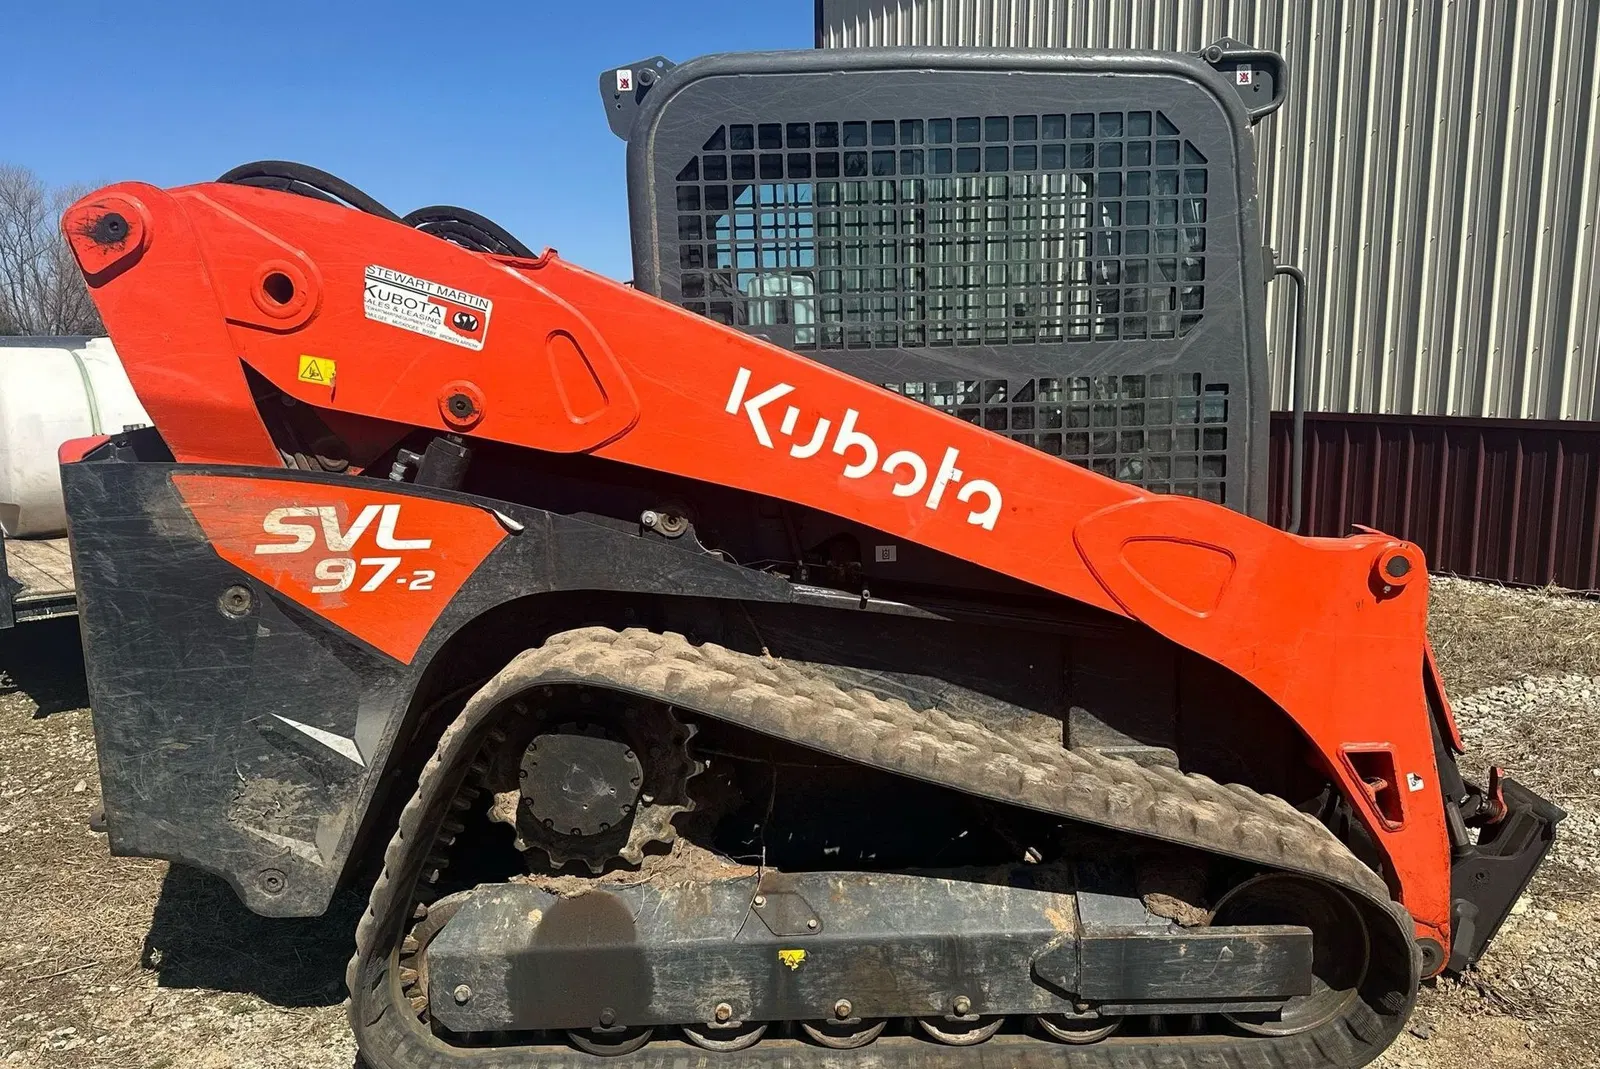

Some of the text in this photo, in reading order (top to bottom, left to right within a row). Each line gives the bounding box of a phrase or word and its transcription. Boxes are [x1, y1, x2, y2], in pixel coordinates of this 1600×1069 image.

[364, 281, 441, 318] KUBOTA
[366, 264, 489, 309] STEWART MARTIN
[392, 301, 399, 312] &
[401, 308, 441, 325] LEASING
[725, 367, 1003, 531] Kubota
[254, 504, 433, 555] SVL
[311, 556, 436, 594] 97-2
